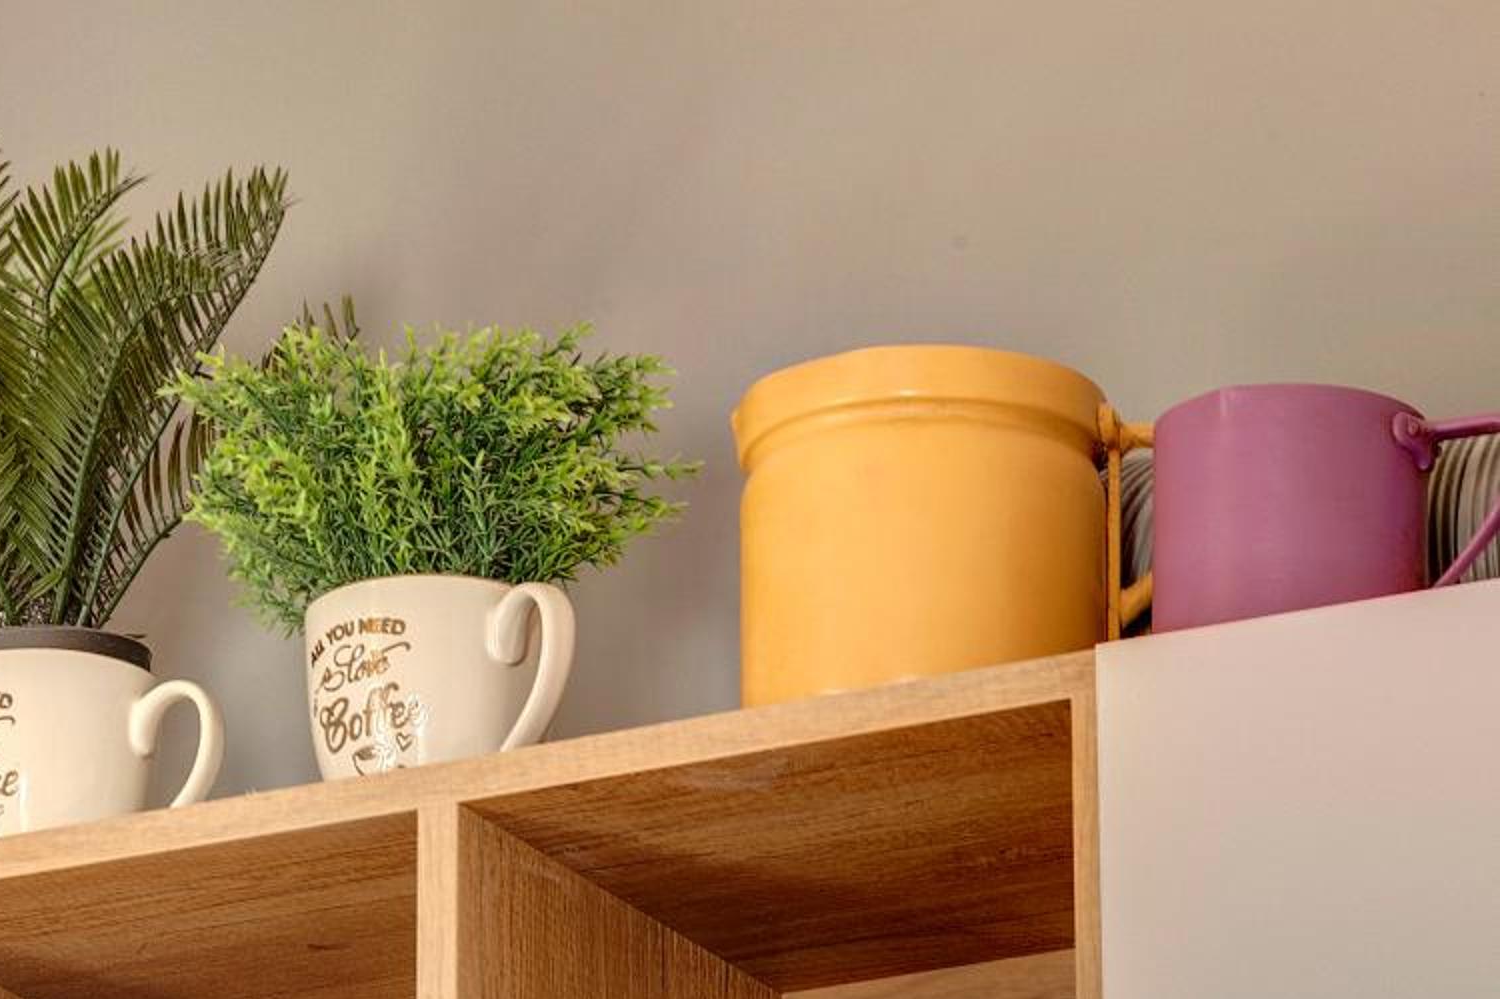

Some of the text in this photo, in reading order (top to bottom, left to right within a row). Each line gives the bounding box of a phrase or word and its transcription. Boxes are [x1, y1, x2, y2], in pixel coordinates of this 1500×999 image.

[311, 617, 406, 668] ALL YOU NEED
